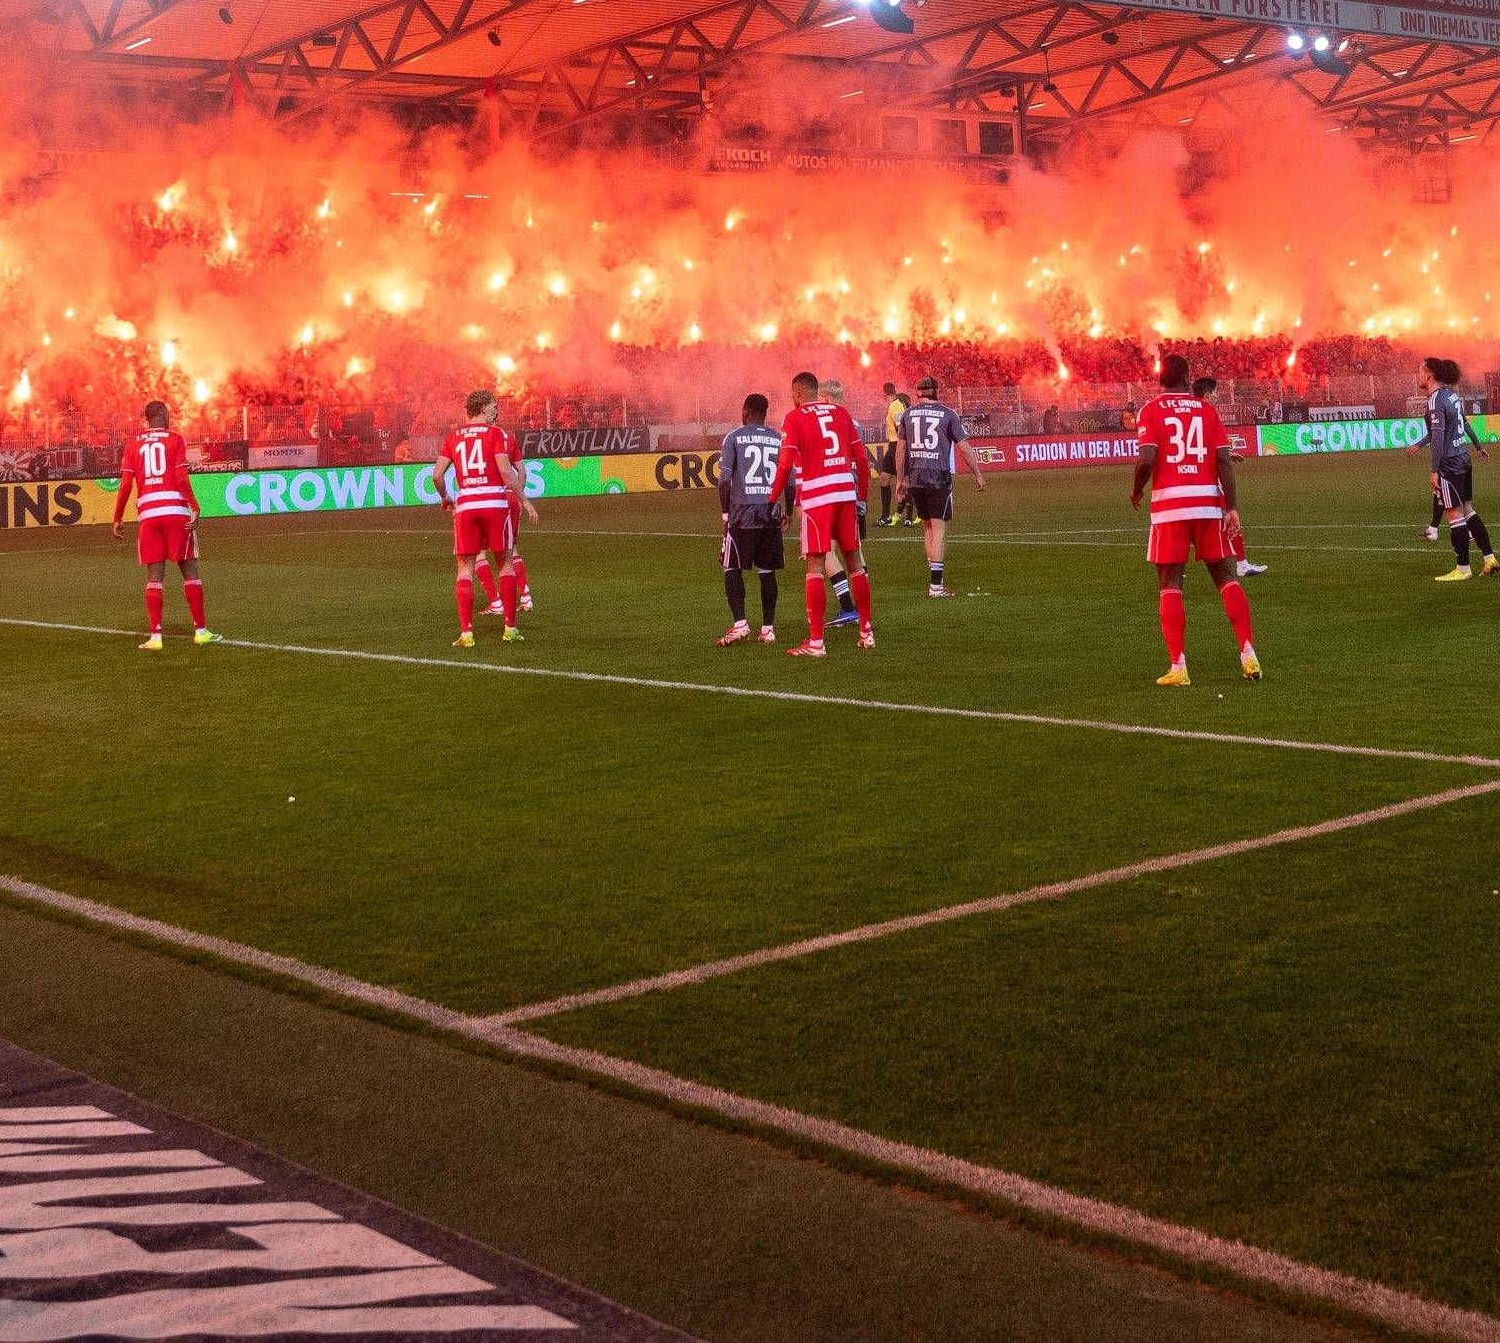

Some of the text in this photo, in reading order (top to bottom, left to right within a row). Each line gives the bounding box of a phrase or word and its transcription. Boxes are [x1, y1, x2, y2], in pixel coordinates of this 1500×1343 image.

[1400, 10, 1426, 34] UND
[1429, 14, 1479, 40] NIEMALS
[726, 148, 772, 163] KOCH
[909, 409, 945, 418] KRISTENSEN
[1167, 399, 1203, 409] FC UNION
[522, 427, 642, 456] FRONTLINE
[817, 415, 840, 456] 5
[911, 416, 941, 450] 13
[1164, 415, 1208, 464] 34
[1295, 420, 1386, 454] CROWN
[138, 442, 167, 478] 10
[455, 438, 487, 477] 14
[744, 444, 779, 486] 25
[1016, 439, 1140, 463] STADION AN DER ALTE
[655, 454, 721, 491] CRO
[225, 467, 404, 516] CROWN
